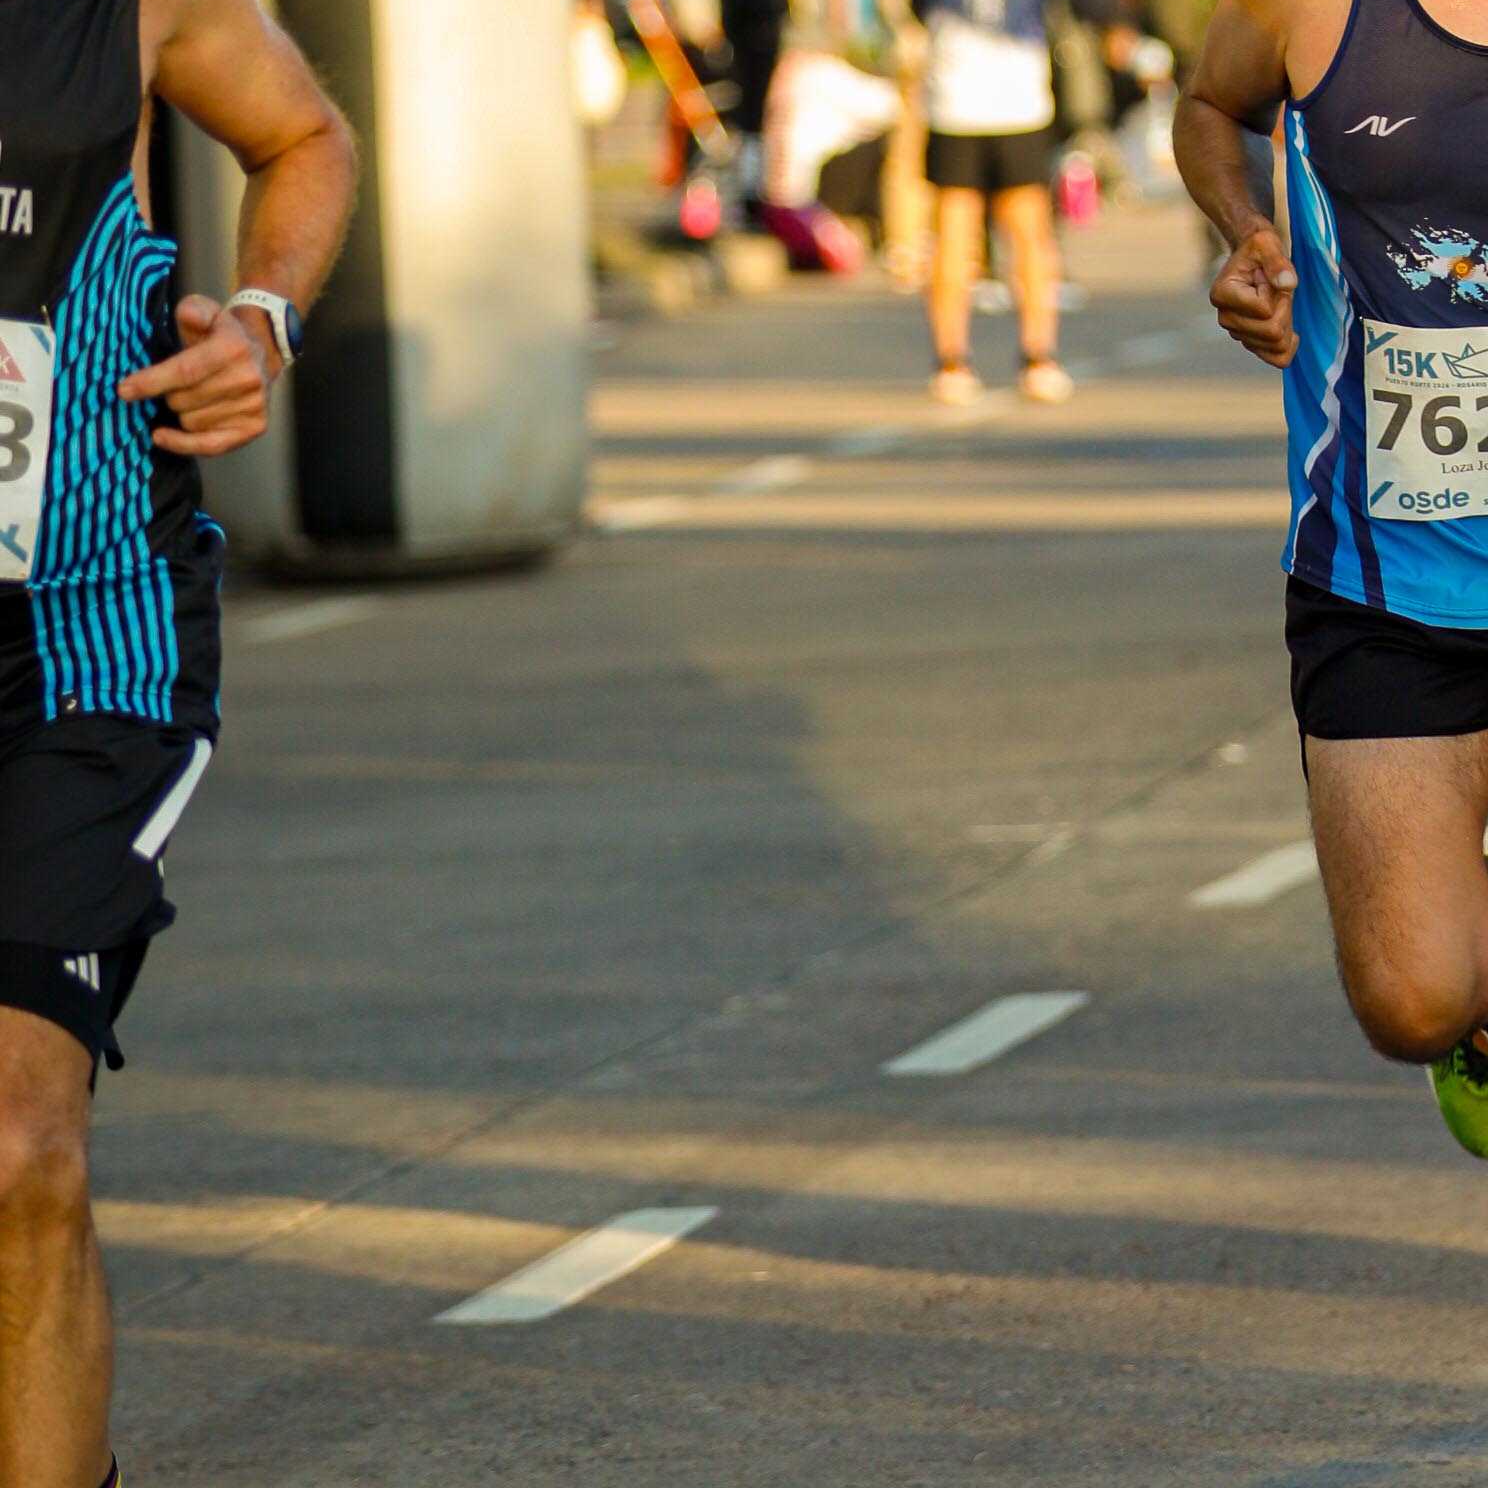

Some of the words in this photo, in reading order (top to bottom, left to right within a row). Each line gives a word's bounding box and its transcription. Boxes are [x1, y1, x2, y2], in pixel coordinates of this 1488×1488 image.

[1383, 347, 1439, 379] 15K
[1441, 462, 1474, 475] Loza
[1398, 488, 1470, 512] osde
